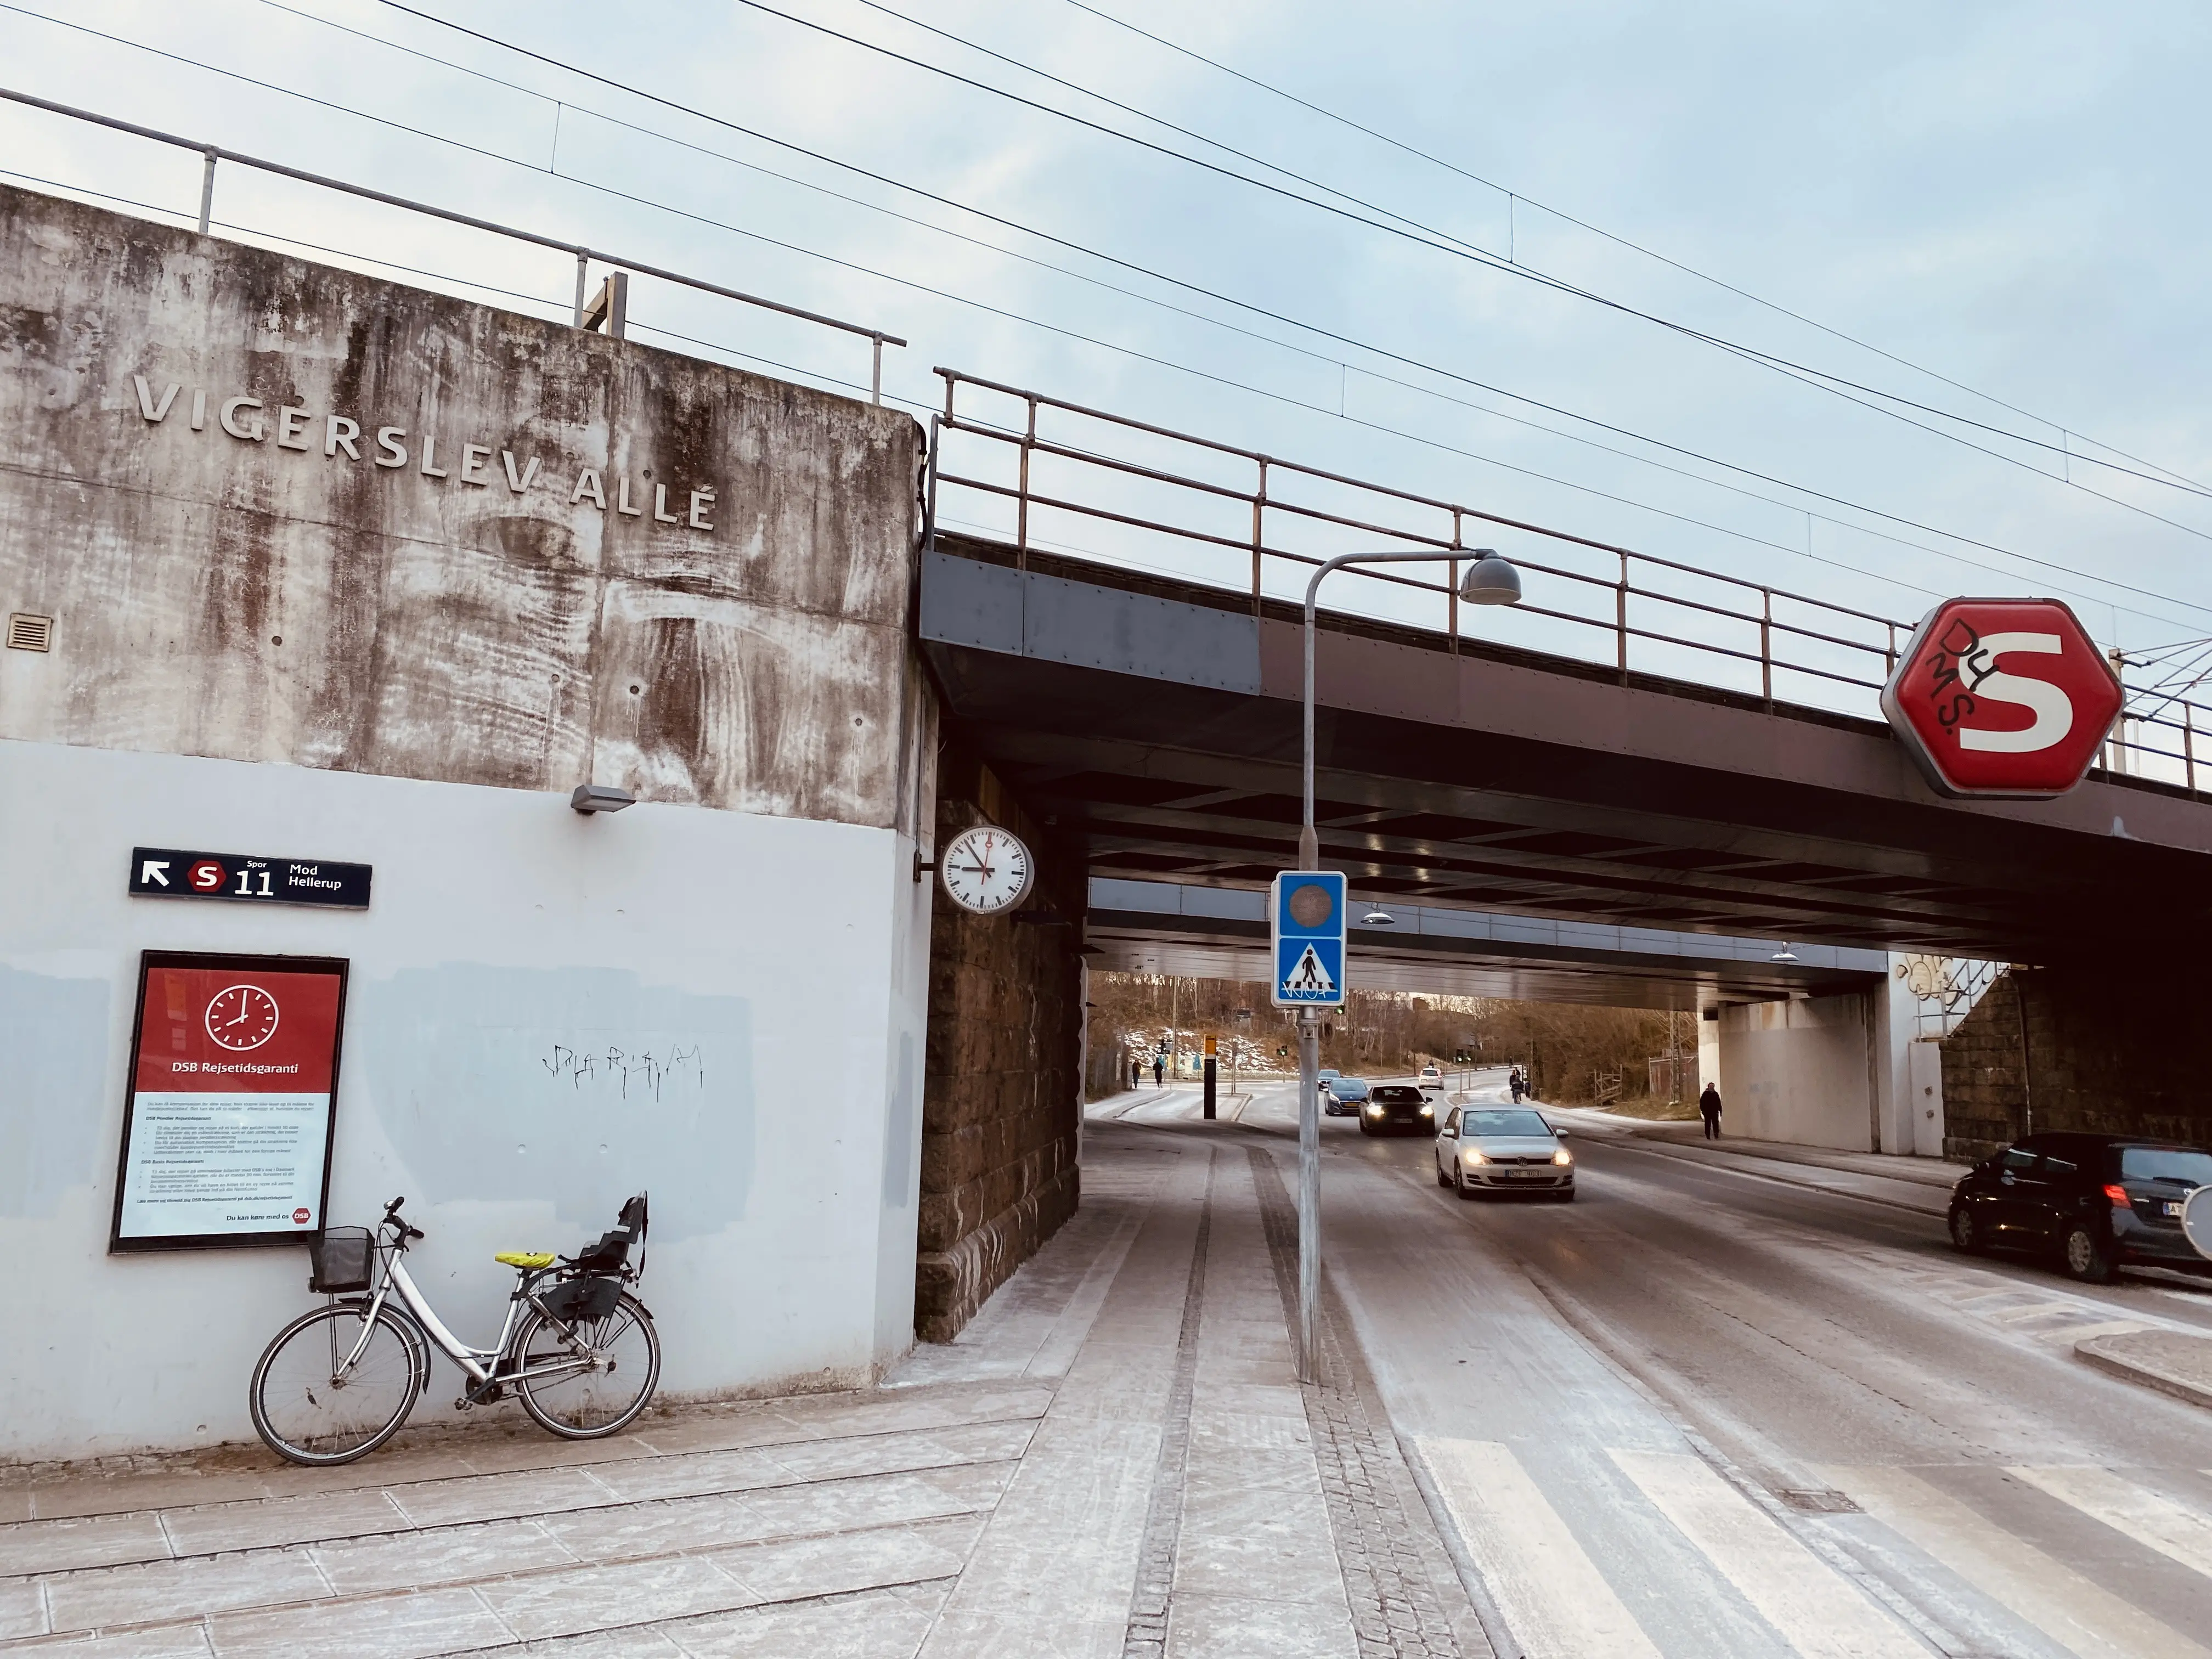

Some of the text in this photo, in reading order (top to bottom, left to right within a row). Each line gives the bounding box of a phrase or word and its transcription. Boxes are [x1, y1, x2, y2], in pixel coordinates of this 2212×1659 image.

[133, 375, 716, 531] VIGERSLEV ALLÉ
[1959, 632, 2073, 753] S
[247, 860, 267, 868] Spor
[290, 864, 318, 876] Mod
[196, 866, 218, 887] S
[234, 870, 274, 896] 11
[289, 876, 342, 890] Hellerup
[172, 1062, 298, 1075] DSB Rejsetidsgaranti
